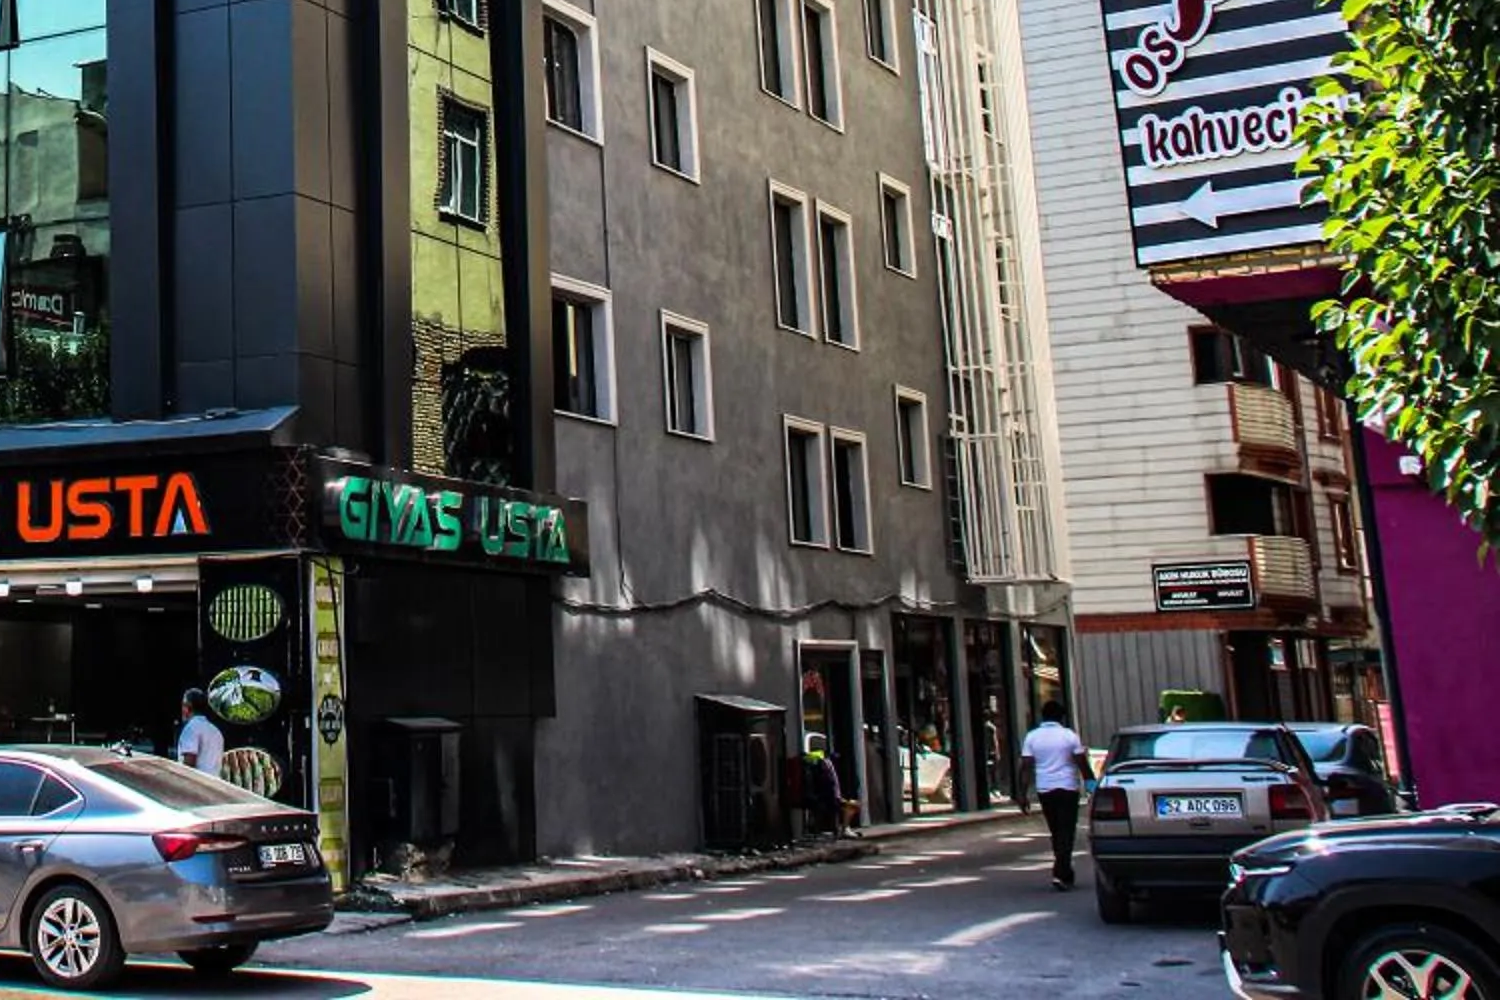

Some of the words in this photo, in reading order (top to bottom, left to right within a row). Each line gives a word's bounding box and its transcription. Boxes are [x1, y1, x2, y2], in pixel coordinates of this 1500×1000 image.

[17, 471, 211, 543] USTA
[339, 475, 464, 552] GIYAS
[479, 493, 571, 564] USTA
